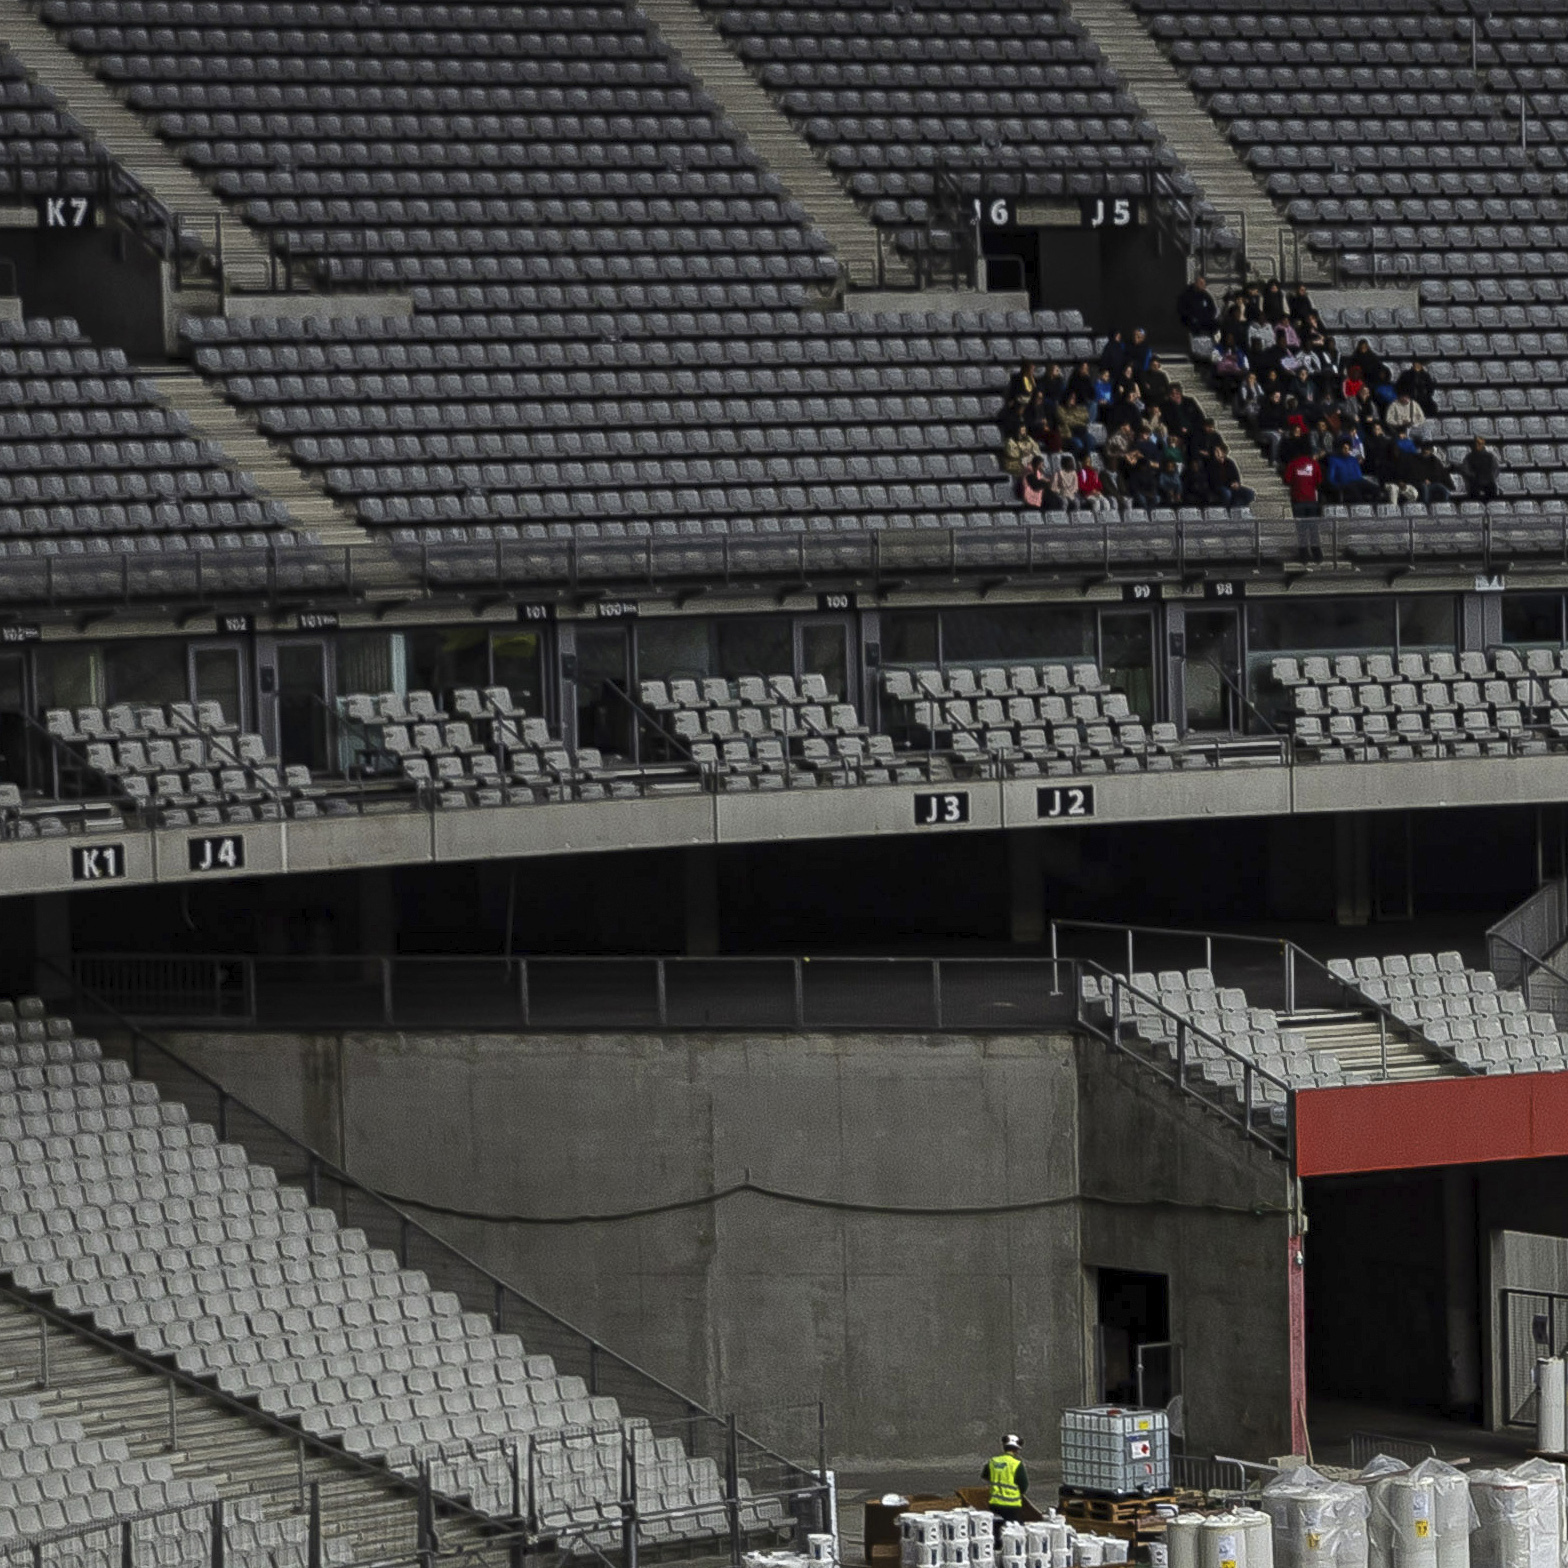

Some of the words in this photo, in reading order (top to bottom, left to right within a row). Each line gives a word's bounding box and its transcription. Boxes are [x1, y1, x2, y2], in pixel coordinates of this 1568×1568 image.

[827, 595, 848, 608] 100
[1134, 585, 1150, 598] 99
[1216, 583, 1232, 595] 98
[926, 796, 960, 822] J3
[1049, 789, 1085, 815] J2
[83, 848, 115, 878] K1
[200, 839, 236, 869] J4
